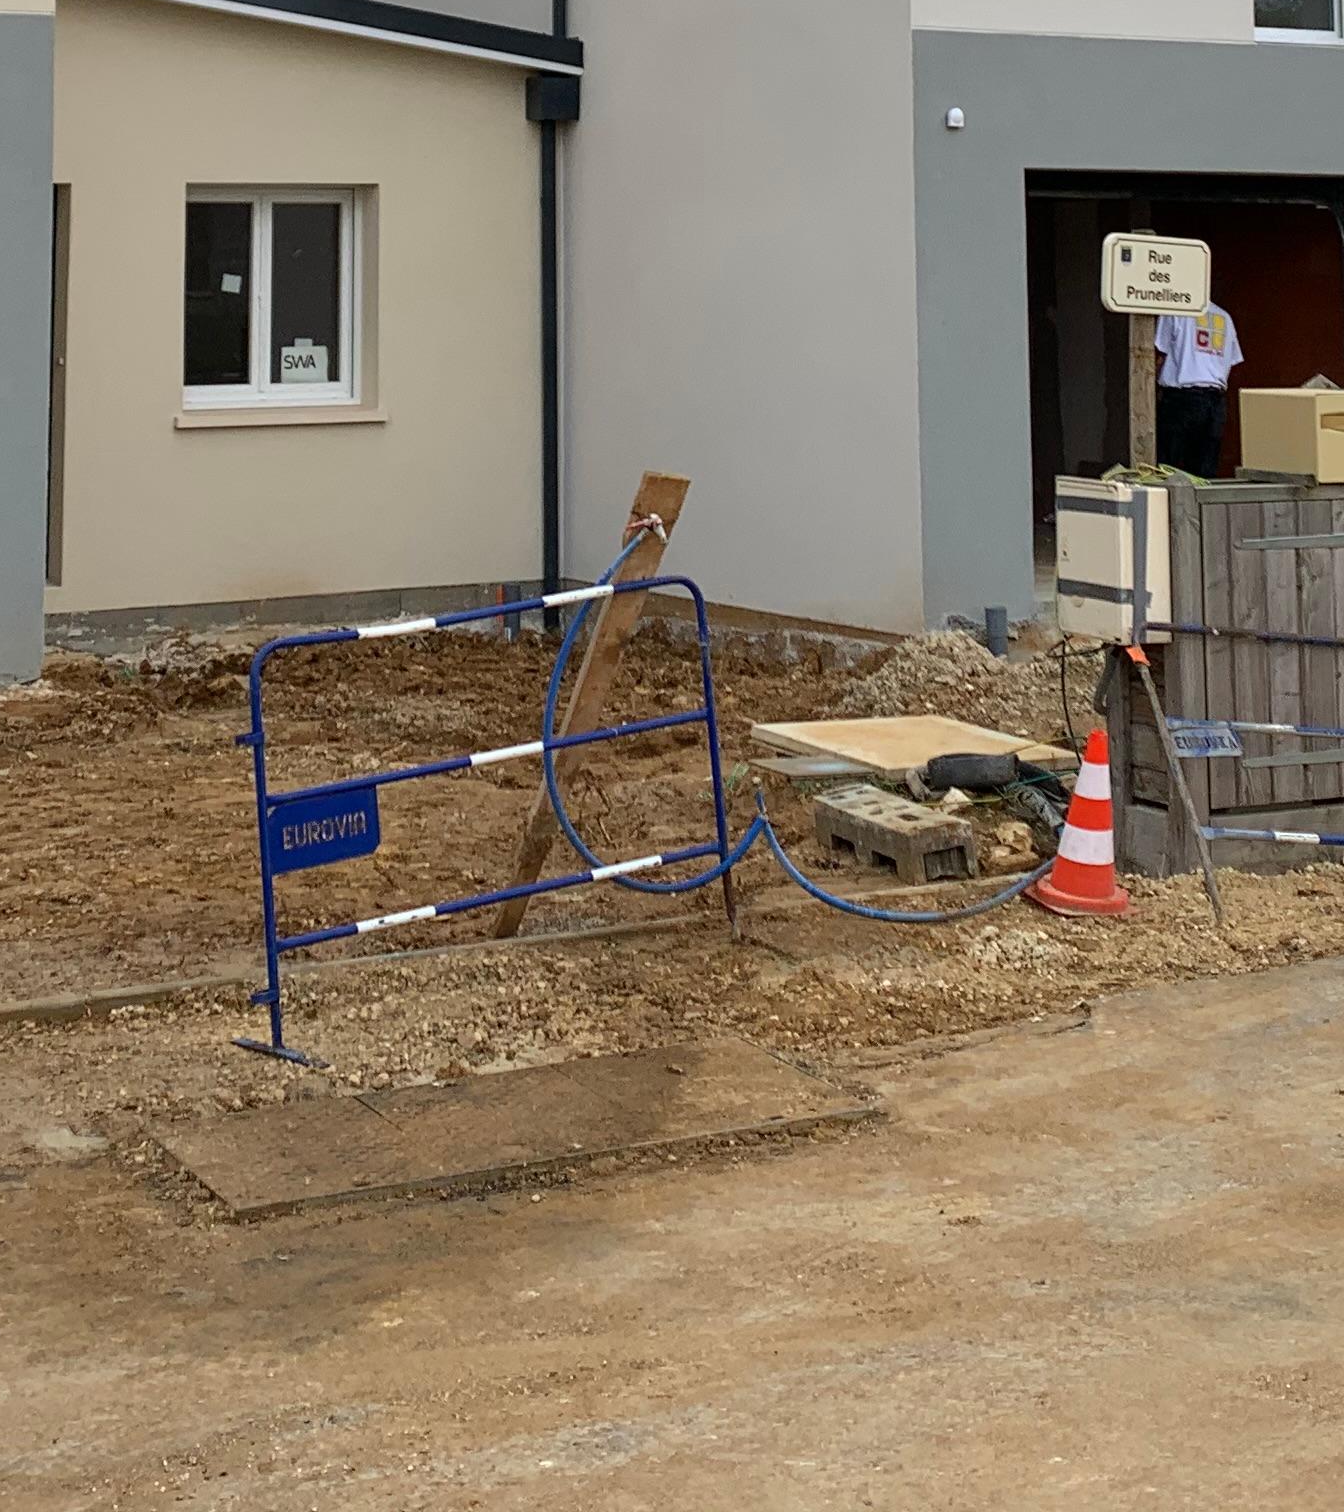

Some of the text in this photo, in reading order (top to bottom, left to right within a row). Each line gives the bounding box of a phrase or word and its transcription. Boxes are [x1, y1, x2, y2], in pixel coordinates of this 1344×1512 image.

[1148, 249, 1172, 265] Rue
[1148, 269, 1171, 284] des
[1126, 285, 1192, 304] Prunelliers
